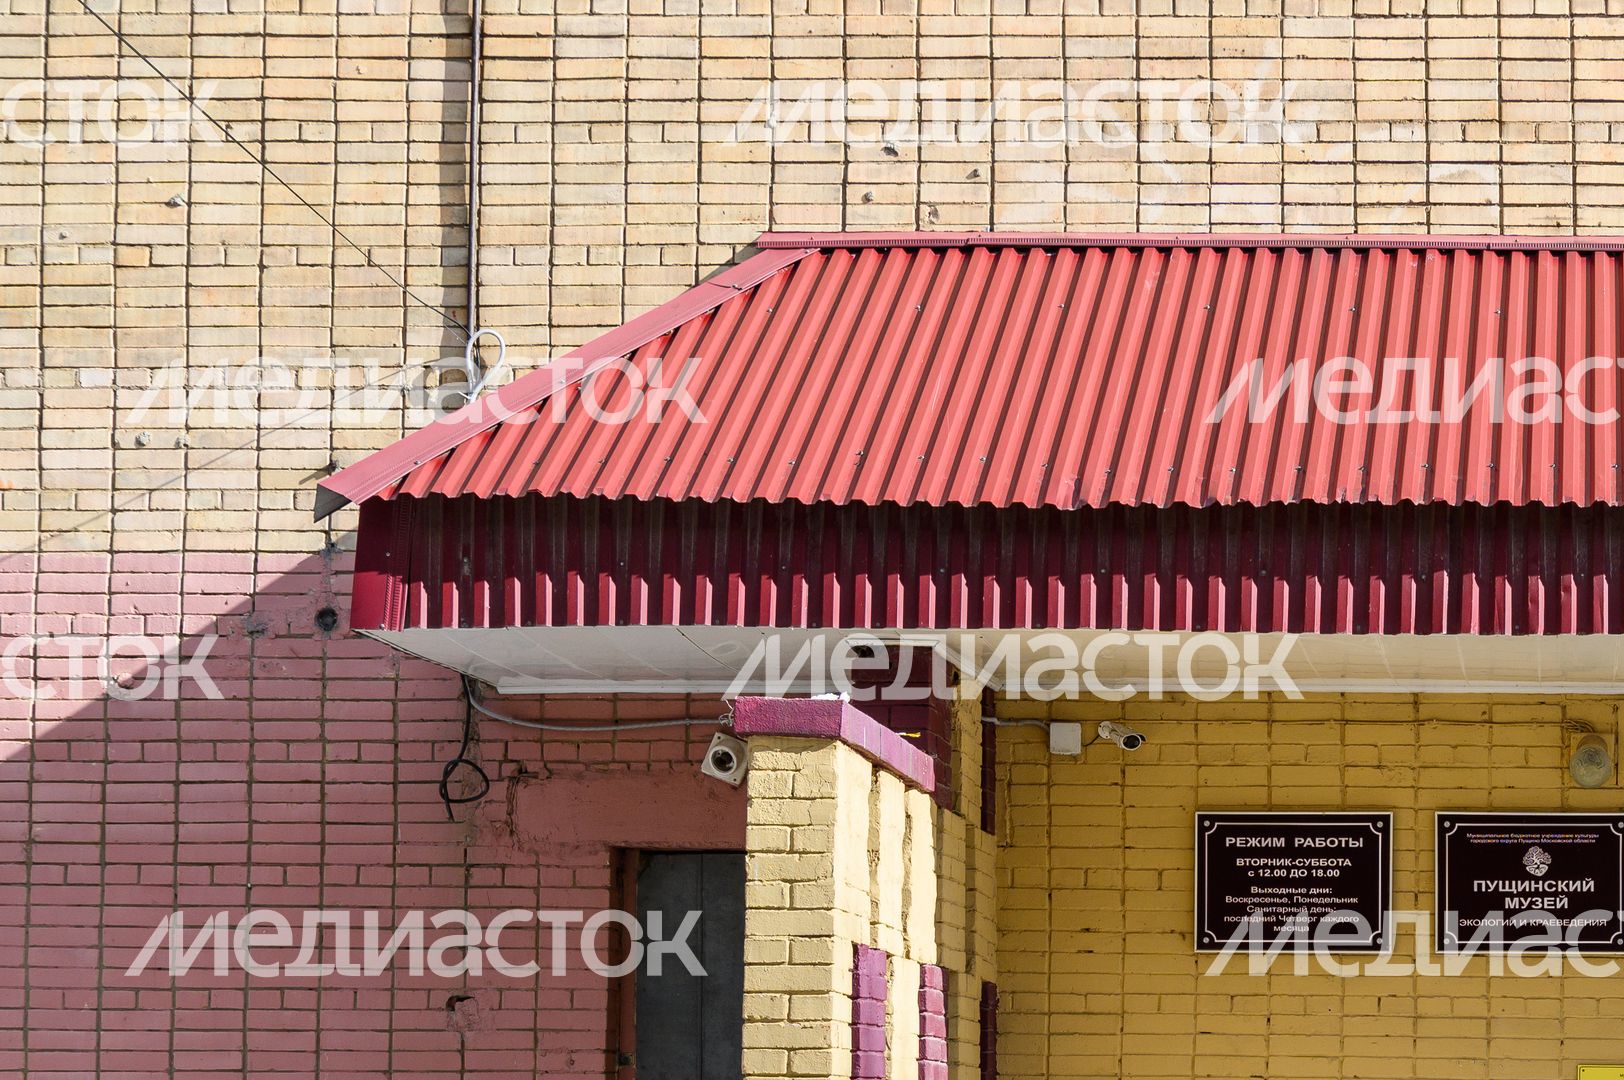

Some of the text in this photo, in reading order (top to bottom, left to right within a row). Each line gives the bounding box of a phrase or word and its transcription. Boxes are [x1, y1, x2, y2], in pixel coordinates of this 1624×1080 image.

[1225, 837, 1364, 848] РЕЖИМ РАБОТЫ
[1236, 858, 1352, 867] ВТОРНИК-СУББОТА
[1258, 869, 1287, 877] 12.00
[1289, 869, 1308, 878] ДО
[1311, 869, 1340, 877] 18.00
[1250, 886, 1307, 894] Выходные
[1473, 878, 1595, 894] ПУЩИНСКИЙ
[1225, 896, 1359, 904] Воскресенье, Понедельник
[1504, 895, 1569, 909] МУЗЕЙ
[1246, 905, 1308, 913] Санитарный
[1529, 919, 1607, 927] КРАЕВЕДЕНИЯ
